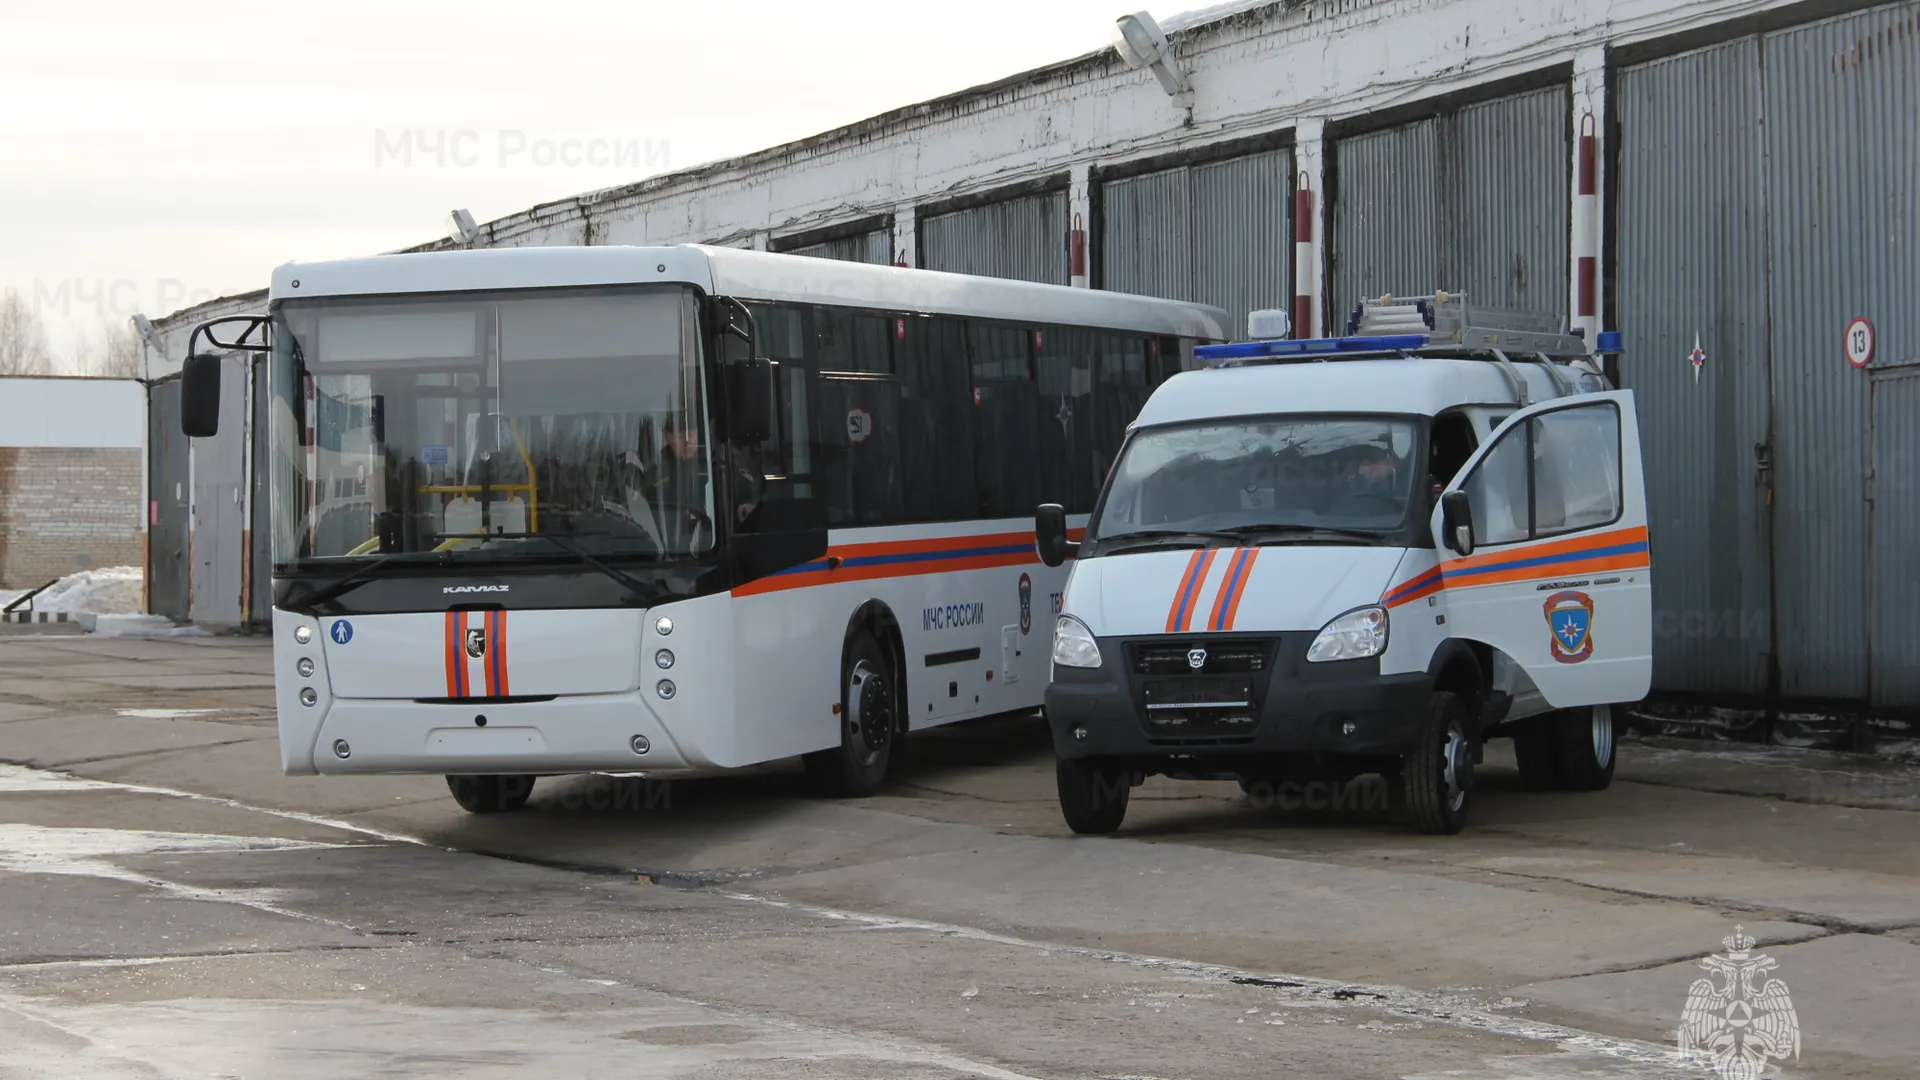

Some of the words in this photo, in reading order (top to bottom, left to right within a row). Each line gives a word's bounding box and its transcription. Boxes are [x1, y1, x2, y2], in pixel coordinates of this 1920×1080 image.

[1853, 330, 1866, 354] 13
[443, 585, 509, 594] KAMAZ
[923, 608, 943, 631] МЧС
[946, 602, 984, 628] РОССИИ
